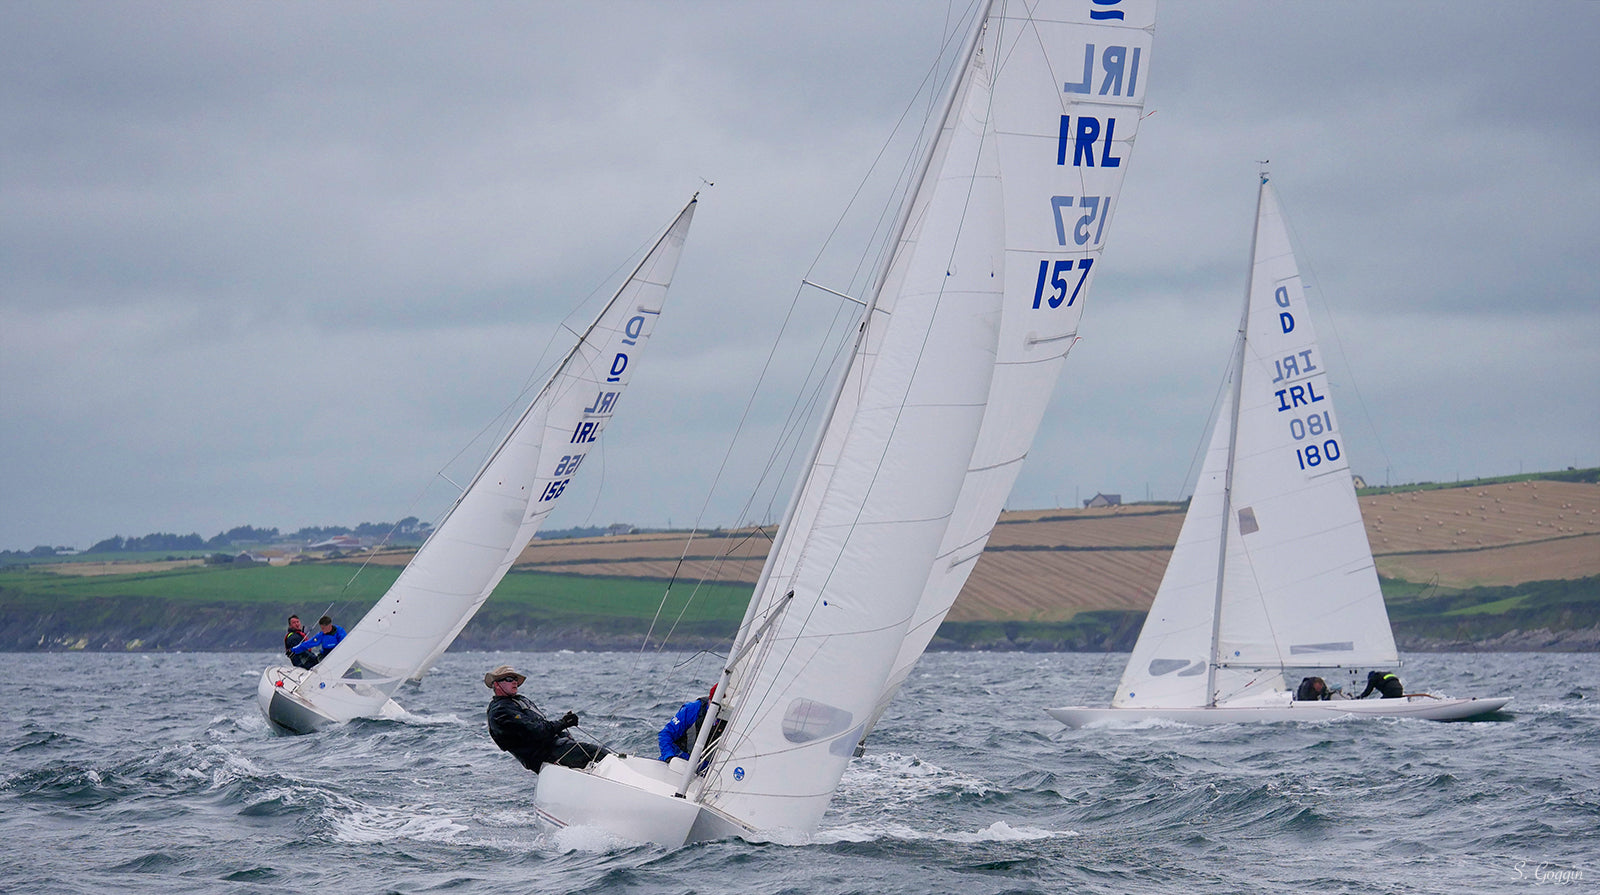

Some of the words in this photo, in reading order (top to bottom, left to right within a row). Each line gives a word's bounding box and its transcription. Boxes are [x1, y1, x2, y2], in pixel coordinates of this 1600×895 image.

[1057, 115, 1121, 167] IRL
[1032, 258, 1094, 309] 157
[1279, 312, 1295, 334] D
[610, 353, 628, 376] D
[1275, 382, 1325, 412] IRL
[570, 422, 600, 443] IRL
[1297, 439, 1341, 470] 180
[539, 478, 570, 502] 156
